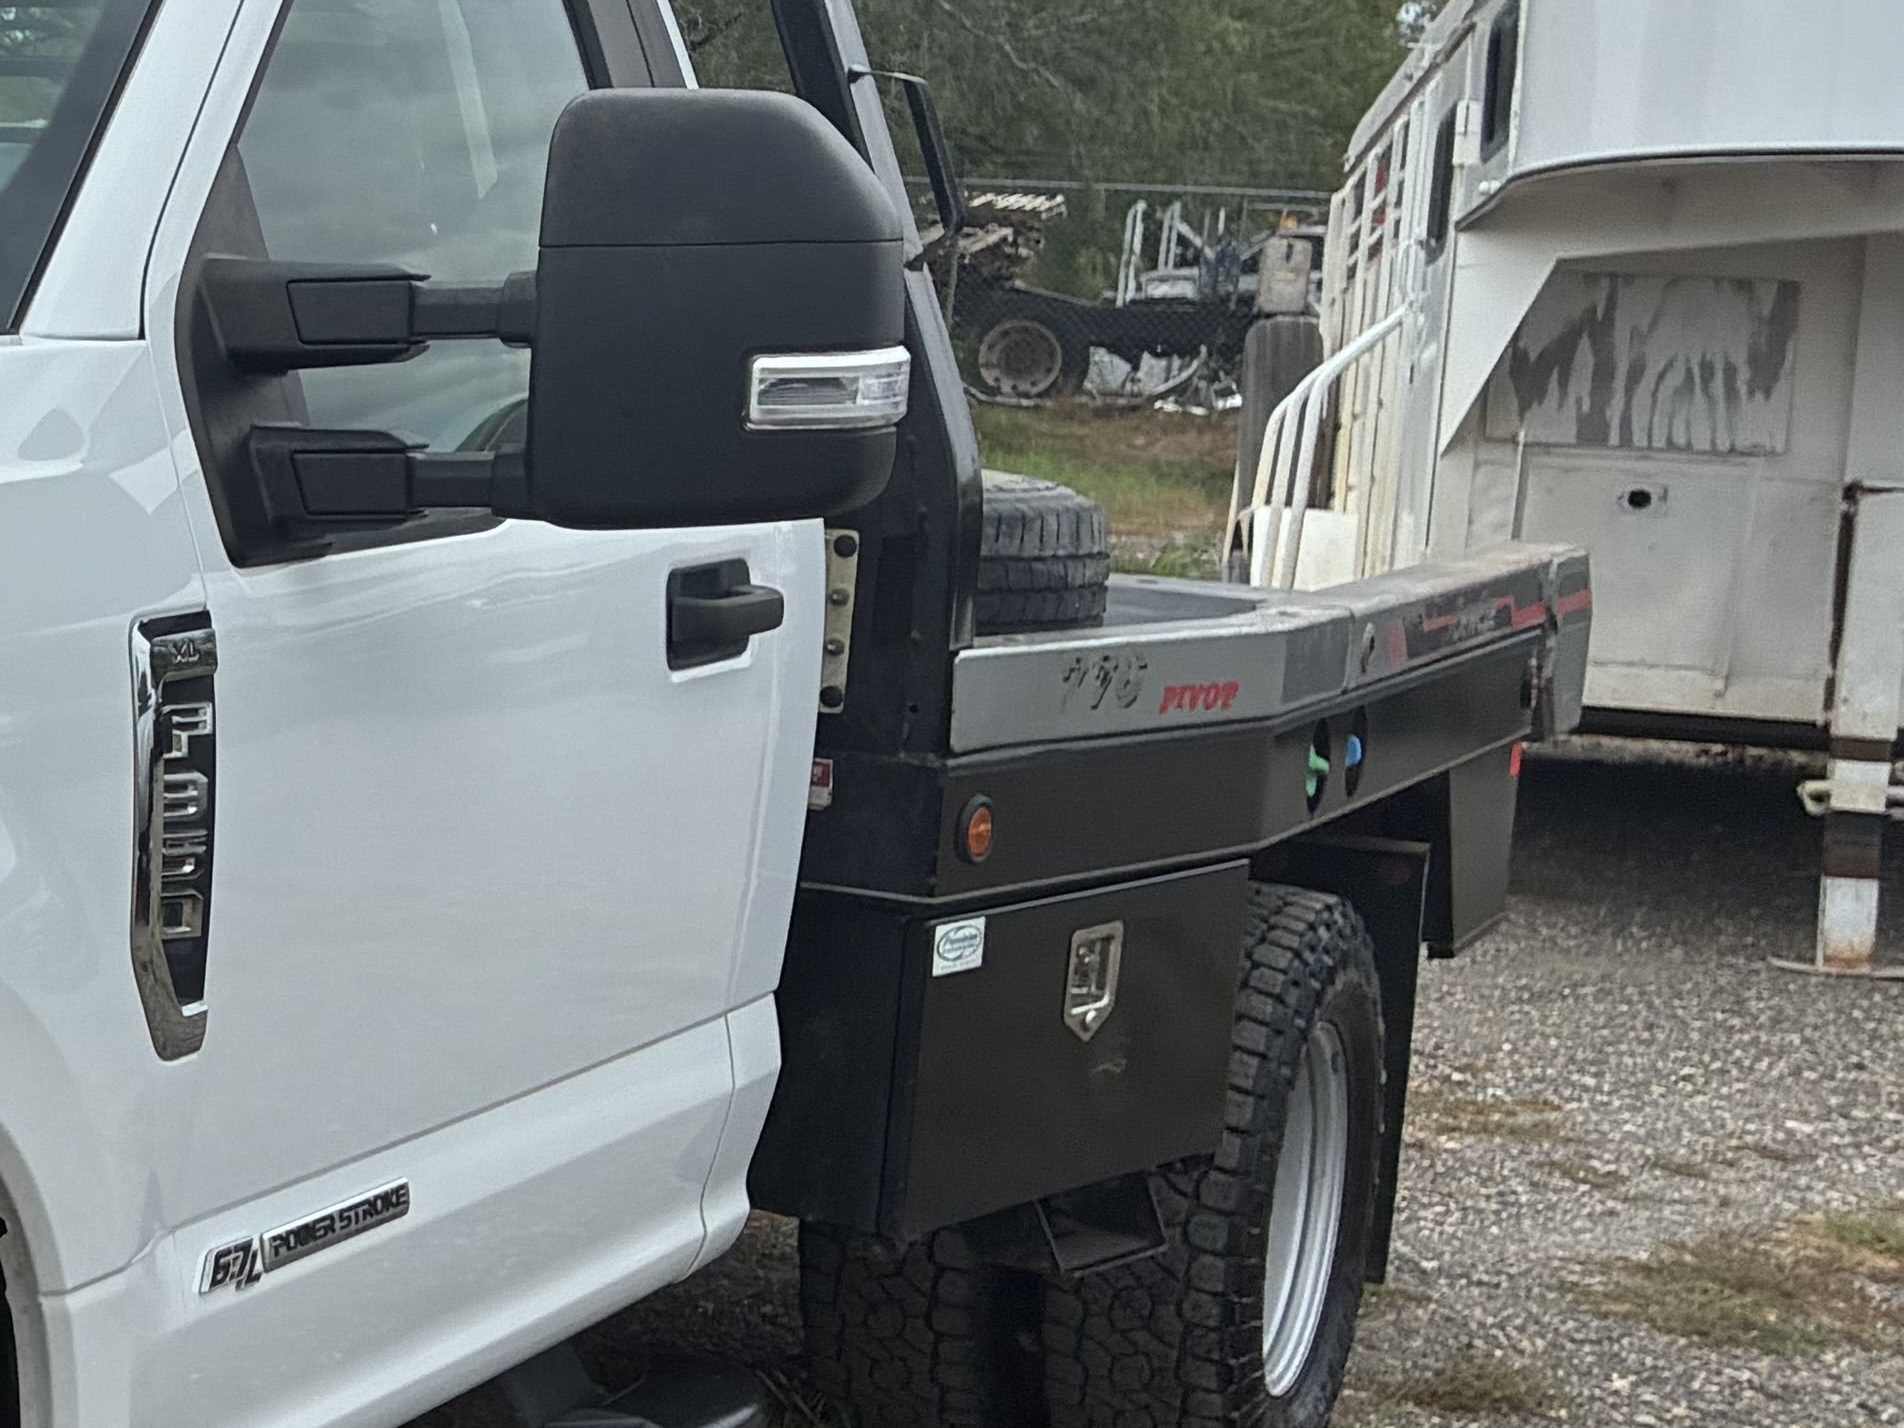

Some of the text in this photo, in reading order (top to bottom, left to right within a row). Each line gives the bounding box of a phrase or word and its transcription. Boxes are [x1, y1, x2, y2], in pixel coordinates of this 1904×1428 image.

[171, 641, 201, 664] XL
[270, 1215, 336, 1258] POWER
[339, 1183, 409, 1230] STROKE
